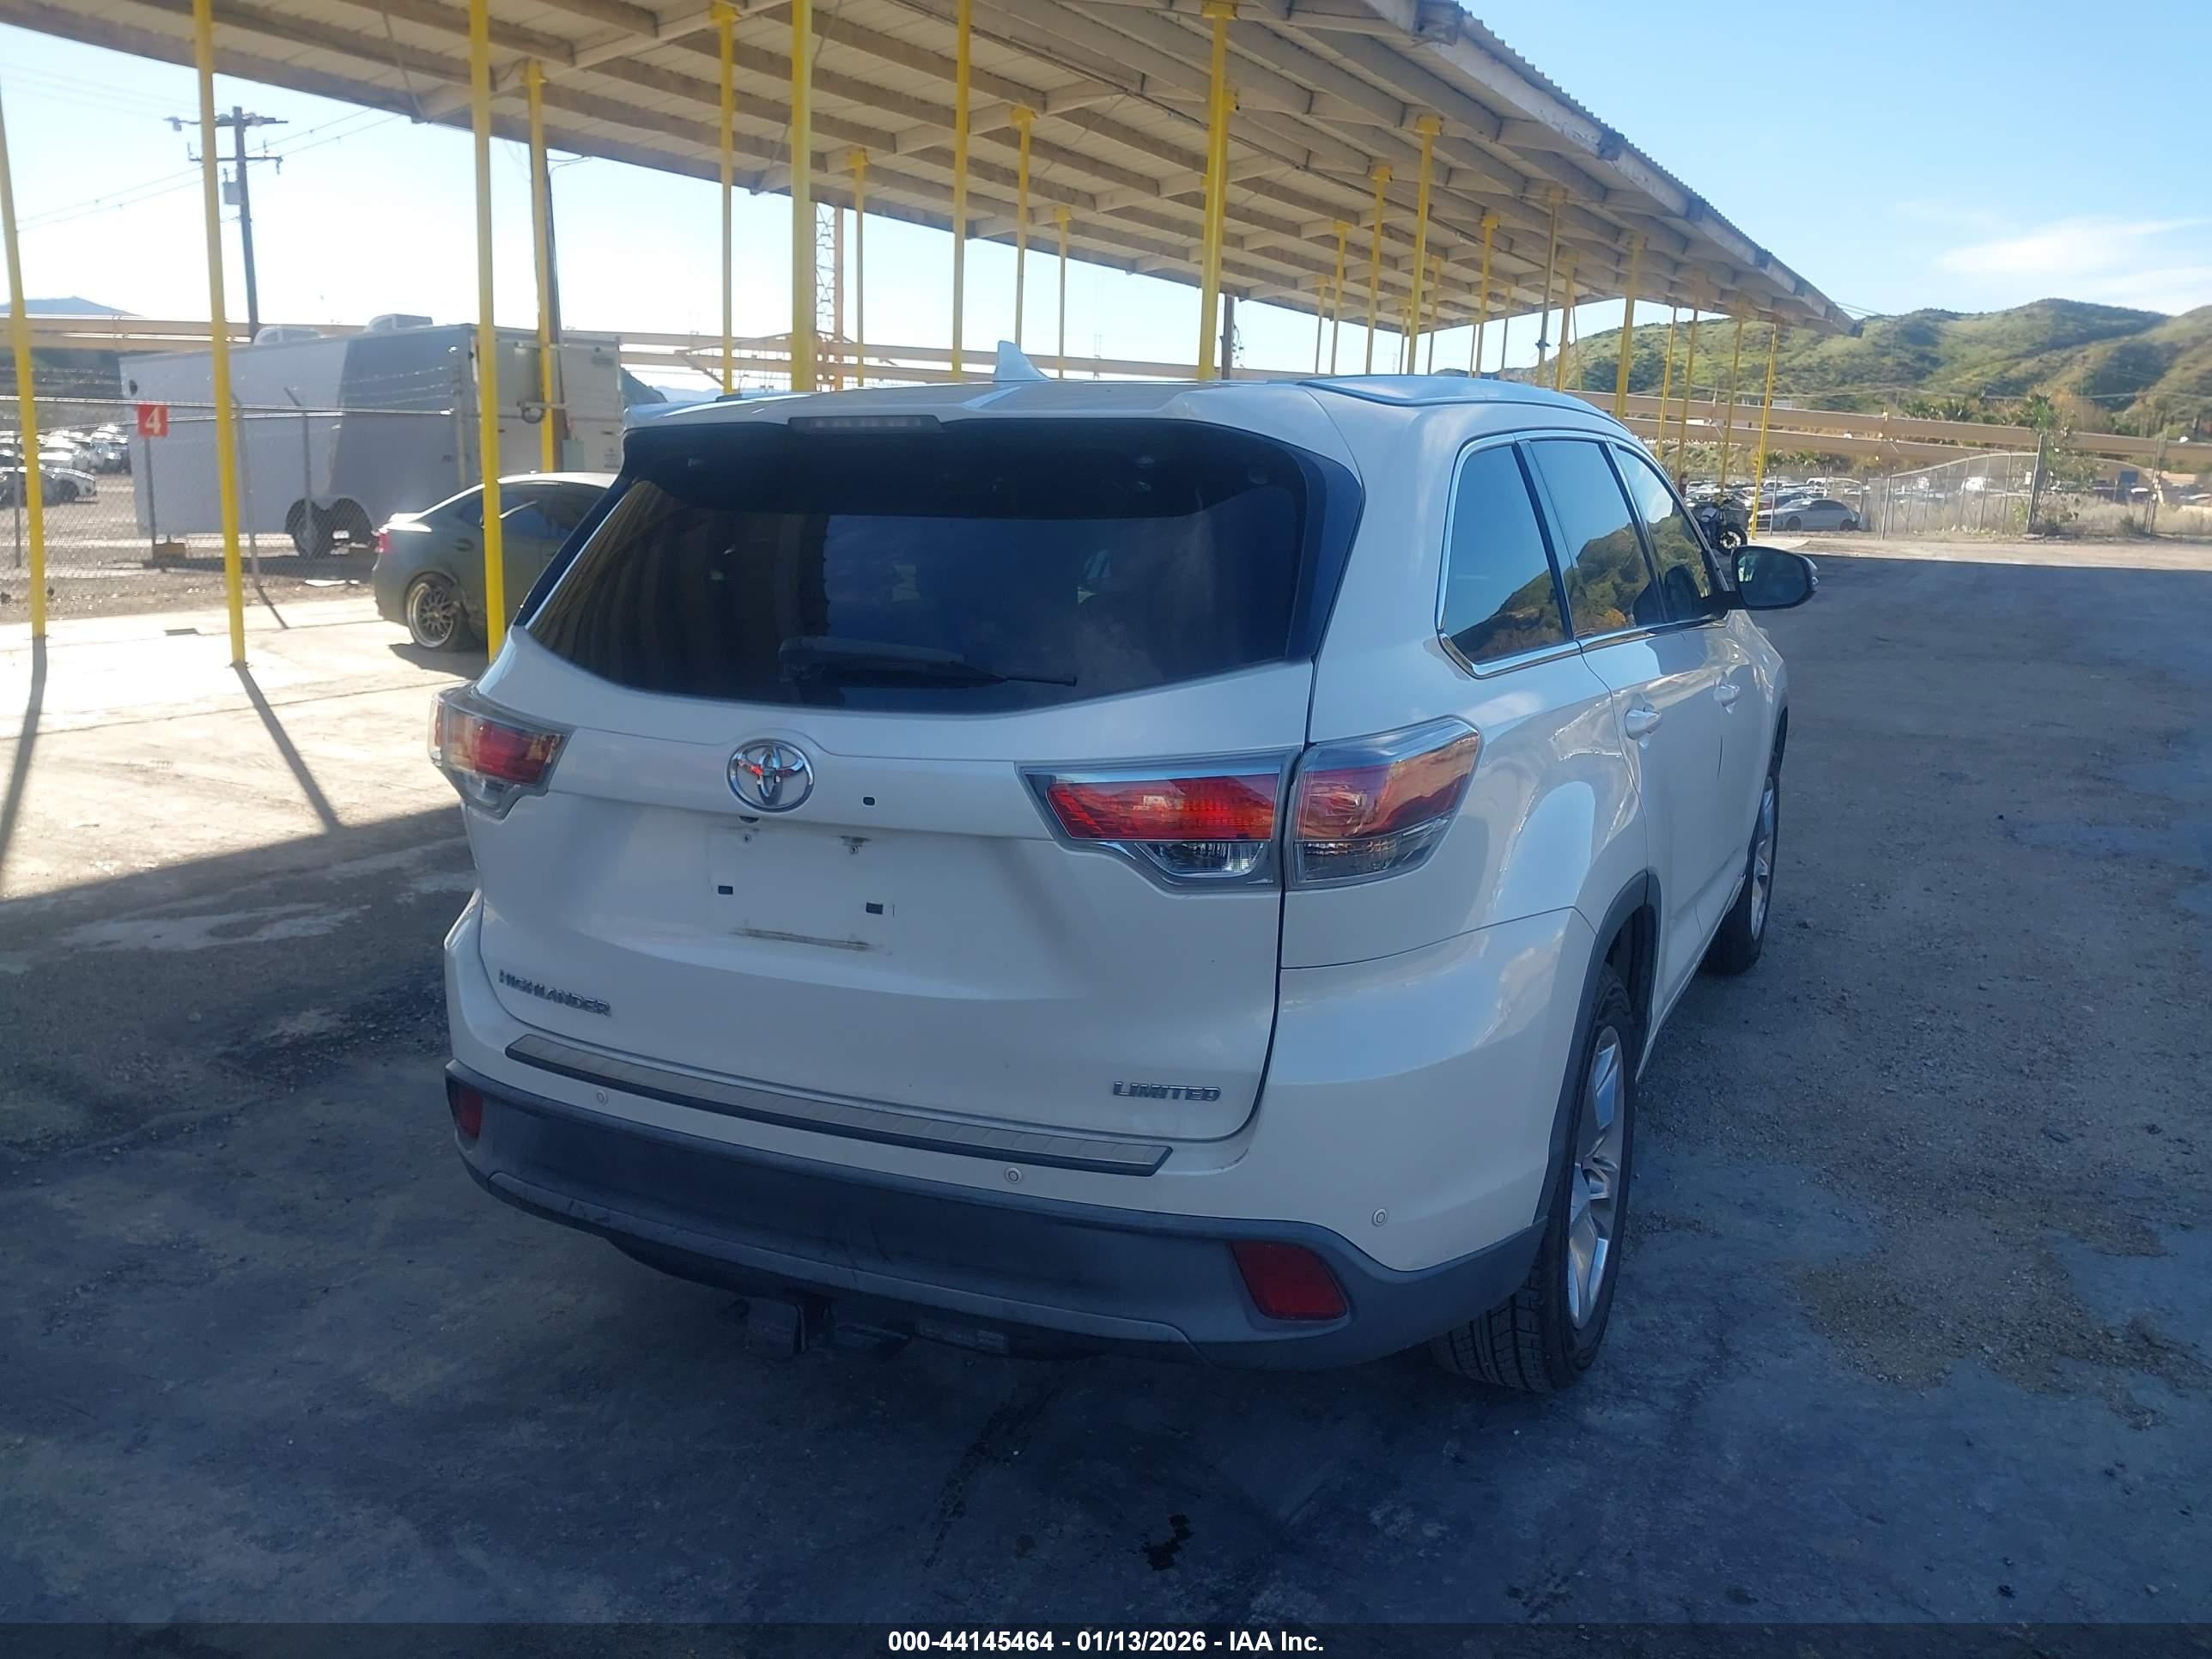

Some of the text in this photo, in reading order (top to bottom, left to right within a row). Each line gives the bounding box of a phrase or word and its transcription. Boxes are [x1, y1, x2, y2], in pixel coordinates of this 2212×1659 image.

[144, 406, 161, 434] 4
[499, 969, 611, 1017] HIGHLANDER
[1113, 1081, 1222, 1102] LIMITED
